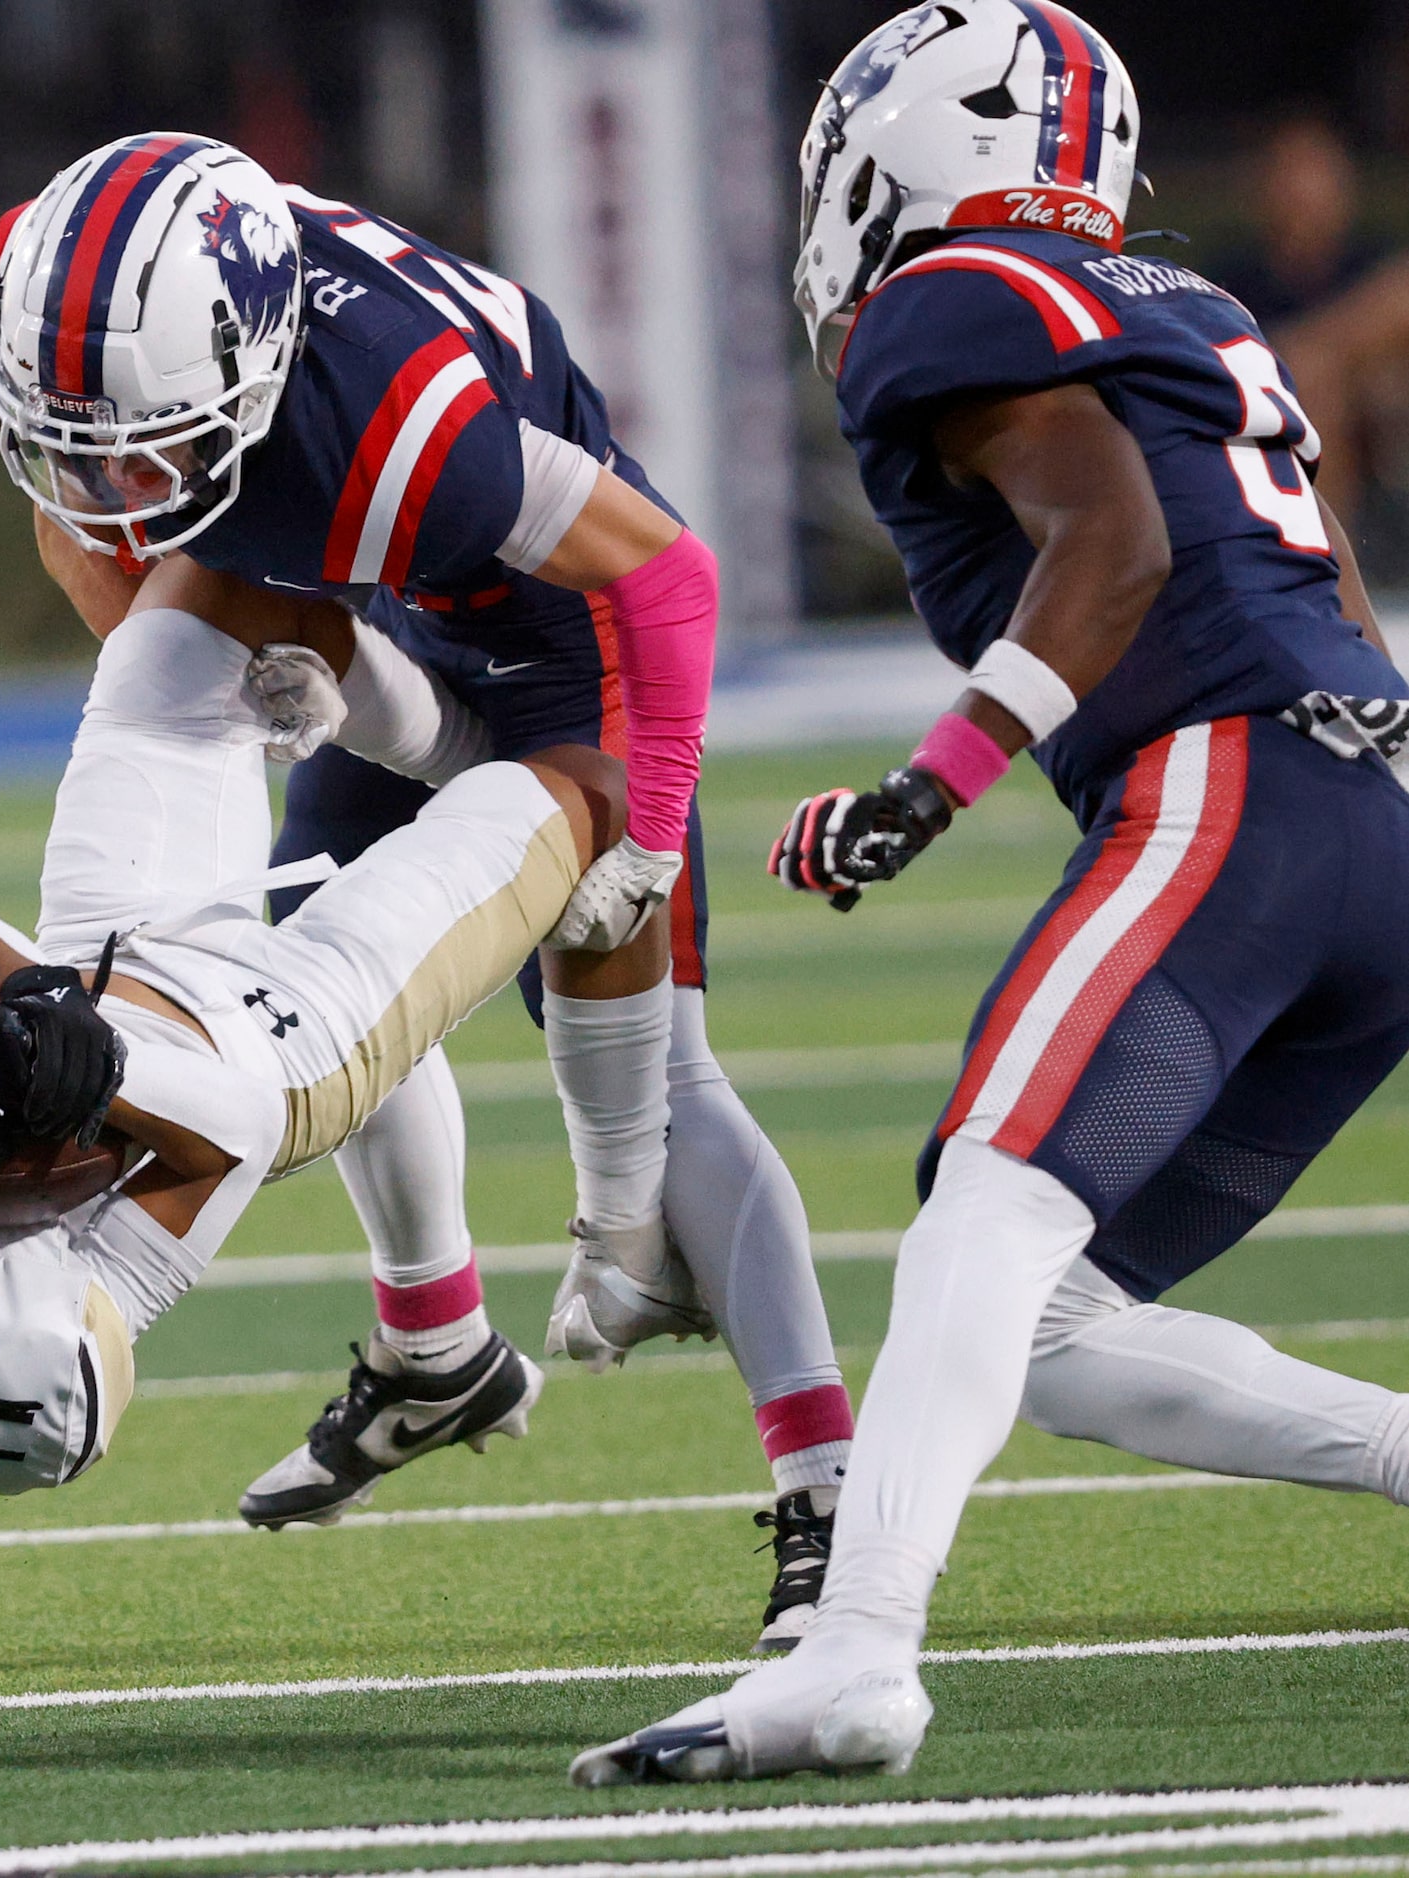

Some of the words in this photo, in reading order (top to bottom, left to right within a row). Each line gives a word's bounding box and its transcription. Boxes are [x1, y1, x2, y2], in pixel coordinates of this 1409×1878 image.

[1003, 191, 1055, 224] The
[1061, 202, 1115, 240] Hills
[42, 393, 96, 414] BELIEVE
